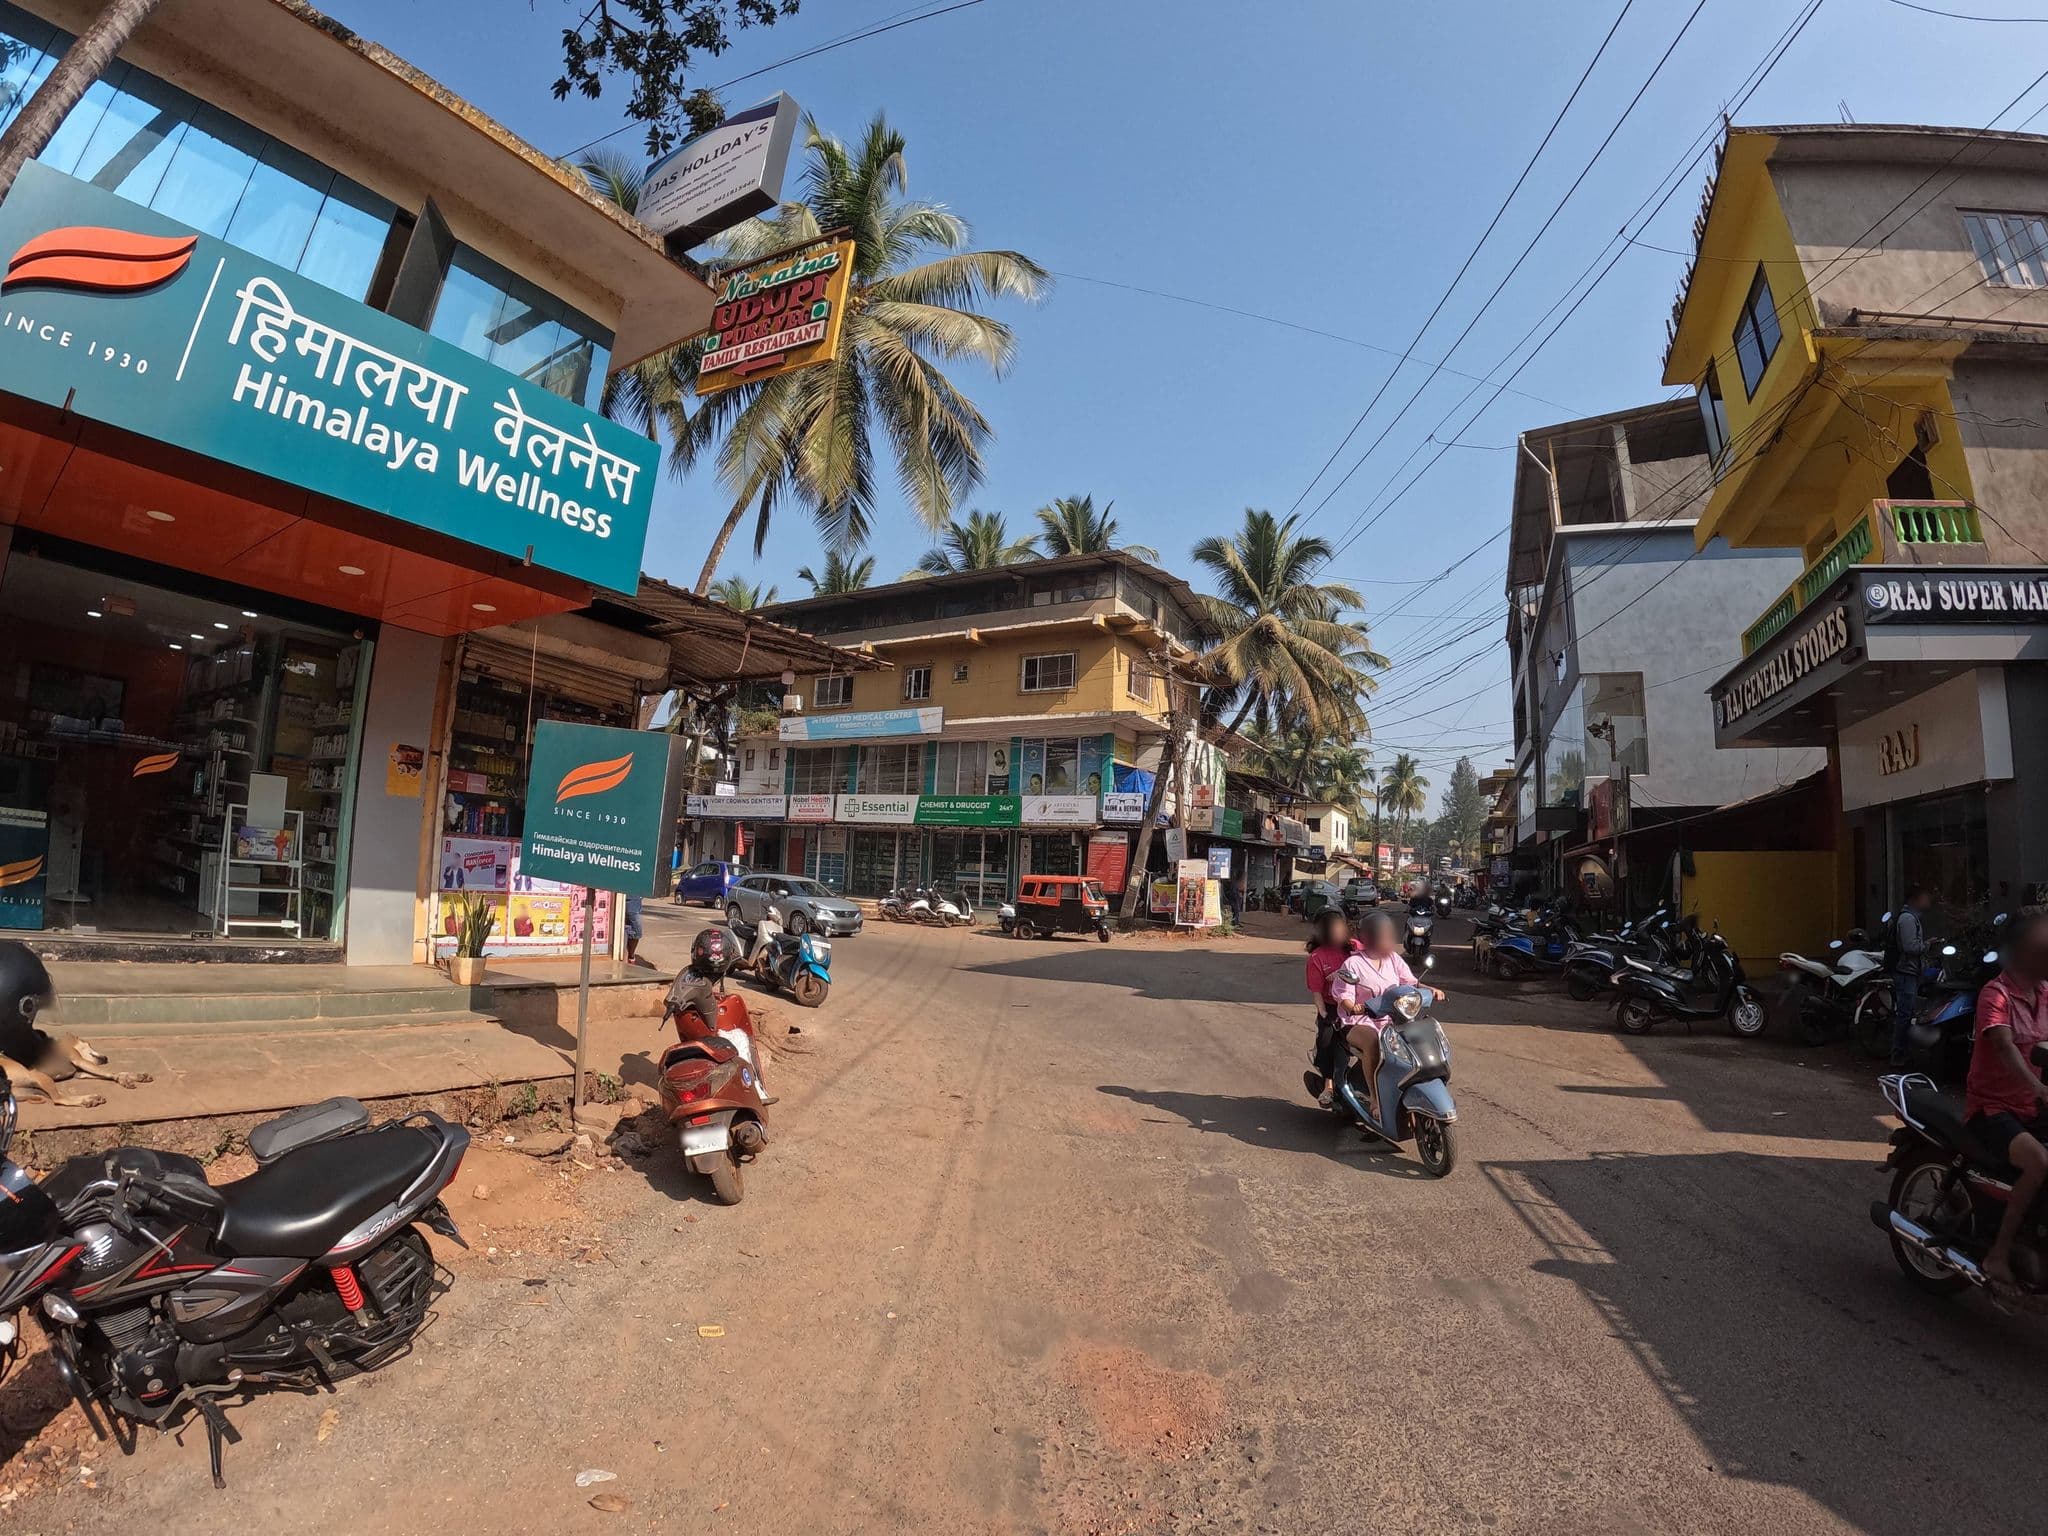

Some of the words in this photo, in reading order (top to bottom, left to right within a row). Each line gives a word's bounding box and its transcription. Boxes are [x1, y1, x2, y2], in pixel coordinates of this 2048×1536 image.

[652, 172, 679, 195] JAS
[682, 121, 769, 176] HOLIDAY'S
[714, 274, 830, 330] UDUPI
[4, 311, 73, 347] INCE
[88, 341, 148, 374] 1930
[703, 346, 745, 371] FAMILY
[744, 323, 820, 358] RESTAURANT
[720, 319, 771, 349] PURE
[774, 309, 810, 331] VEG
[228, 276, 469, 431] हिमालया
[493, 387, 640, 504] वेलनेस
[232, 364, 439, 472] Himalaya
[458, 448, 612, 538] Wellness
[1887, 580, 1932, 611] RAJ
[1938, 580, 2008, 611] SUPER
[1726, 684, 1744, 723] RAJ
[1744, 649, 1794, 710] GENERAL
[1793, 606, 1848, 678] STORES
[852, 713, 882, 722] MEDICAL
[884, 711, 913, 719] CENTRE
[1879, 724, 1919, 776] RAJ
[554, 807, 591, 820] SINCE
[598, 814, 626, 825] 1930
[862, 801, 909, 812] Essential
[920, 801, 949, 809] CHEMIST
[531, 843, 584, 864] Himalaya
[588, 852, 641, 872] Wellness
[533, 831, 578, 846] Гималайская
[578, 840, 642, 856] оздоровительная
